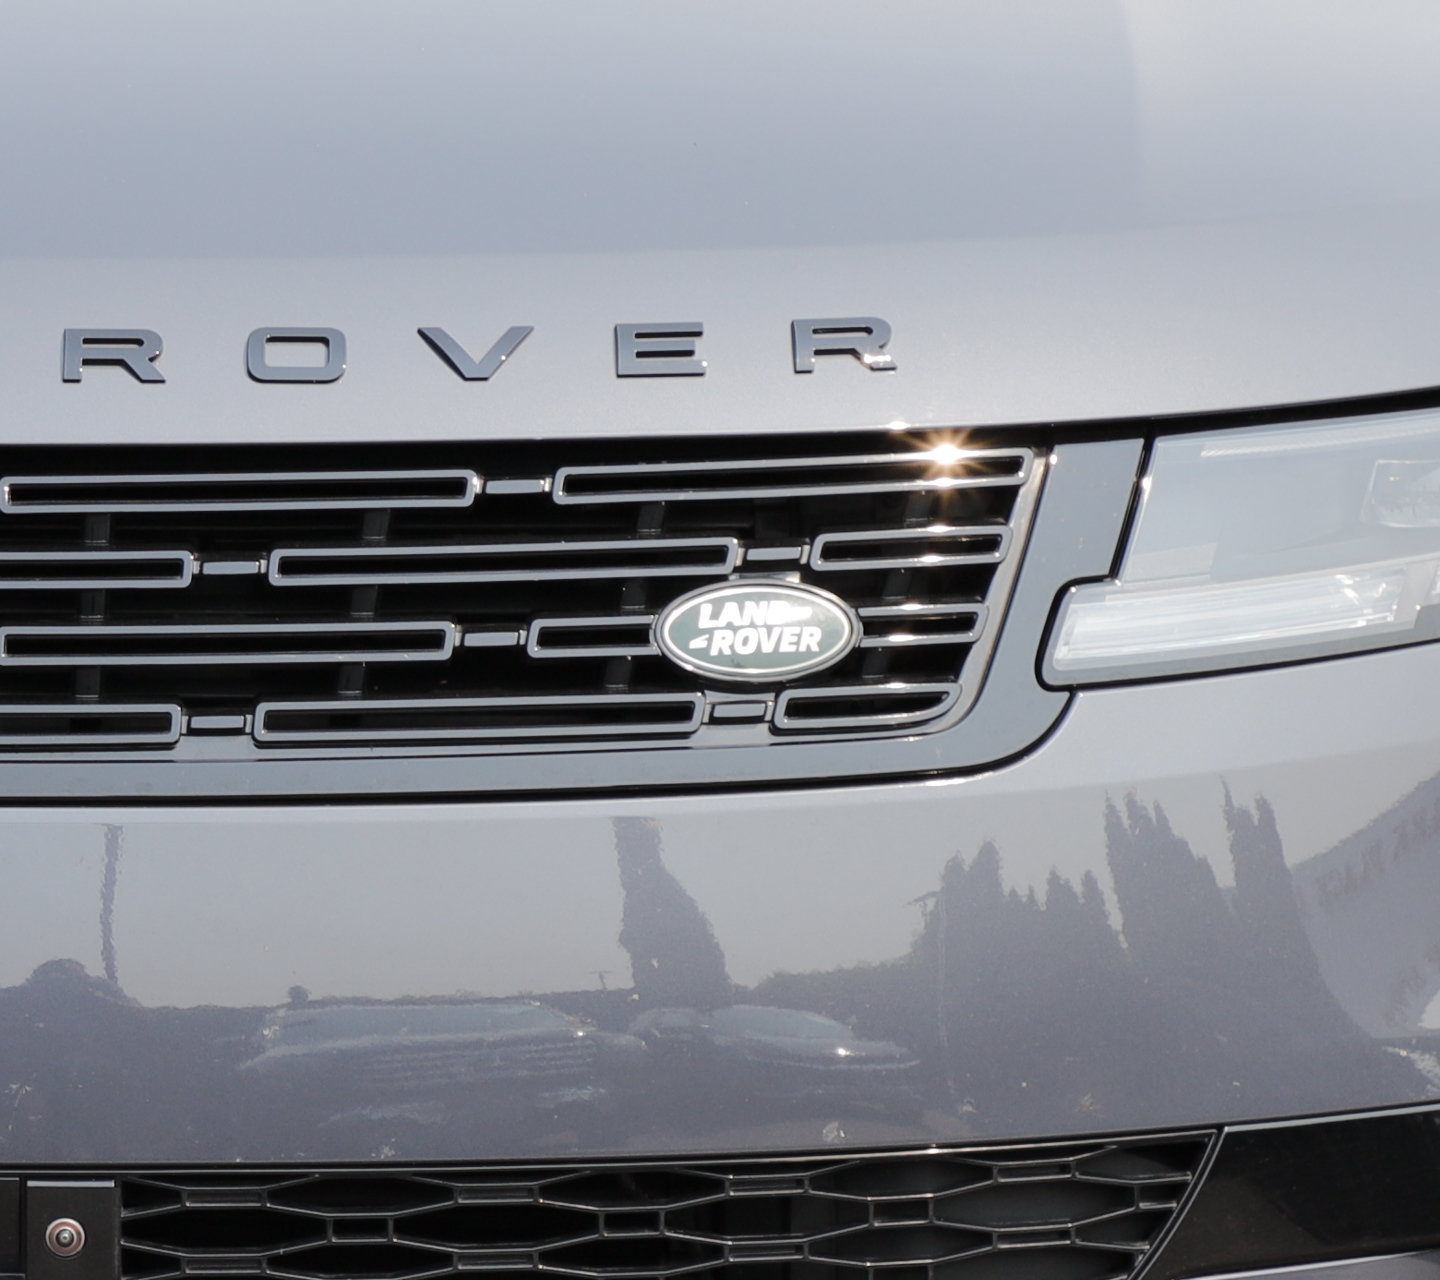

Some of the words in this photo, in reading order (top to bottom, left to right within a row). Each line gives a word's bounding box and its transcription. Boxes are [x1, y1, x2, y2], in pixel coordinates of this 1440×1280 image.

[62, 312, 896, 384] ROVER
[698, 600, 792, 628] LAND
[710, 626, 822, 656] ROVER
